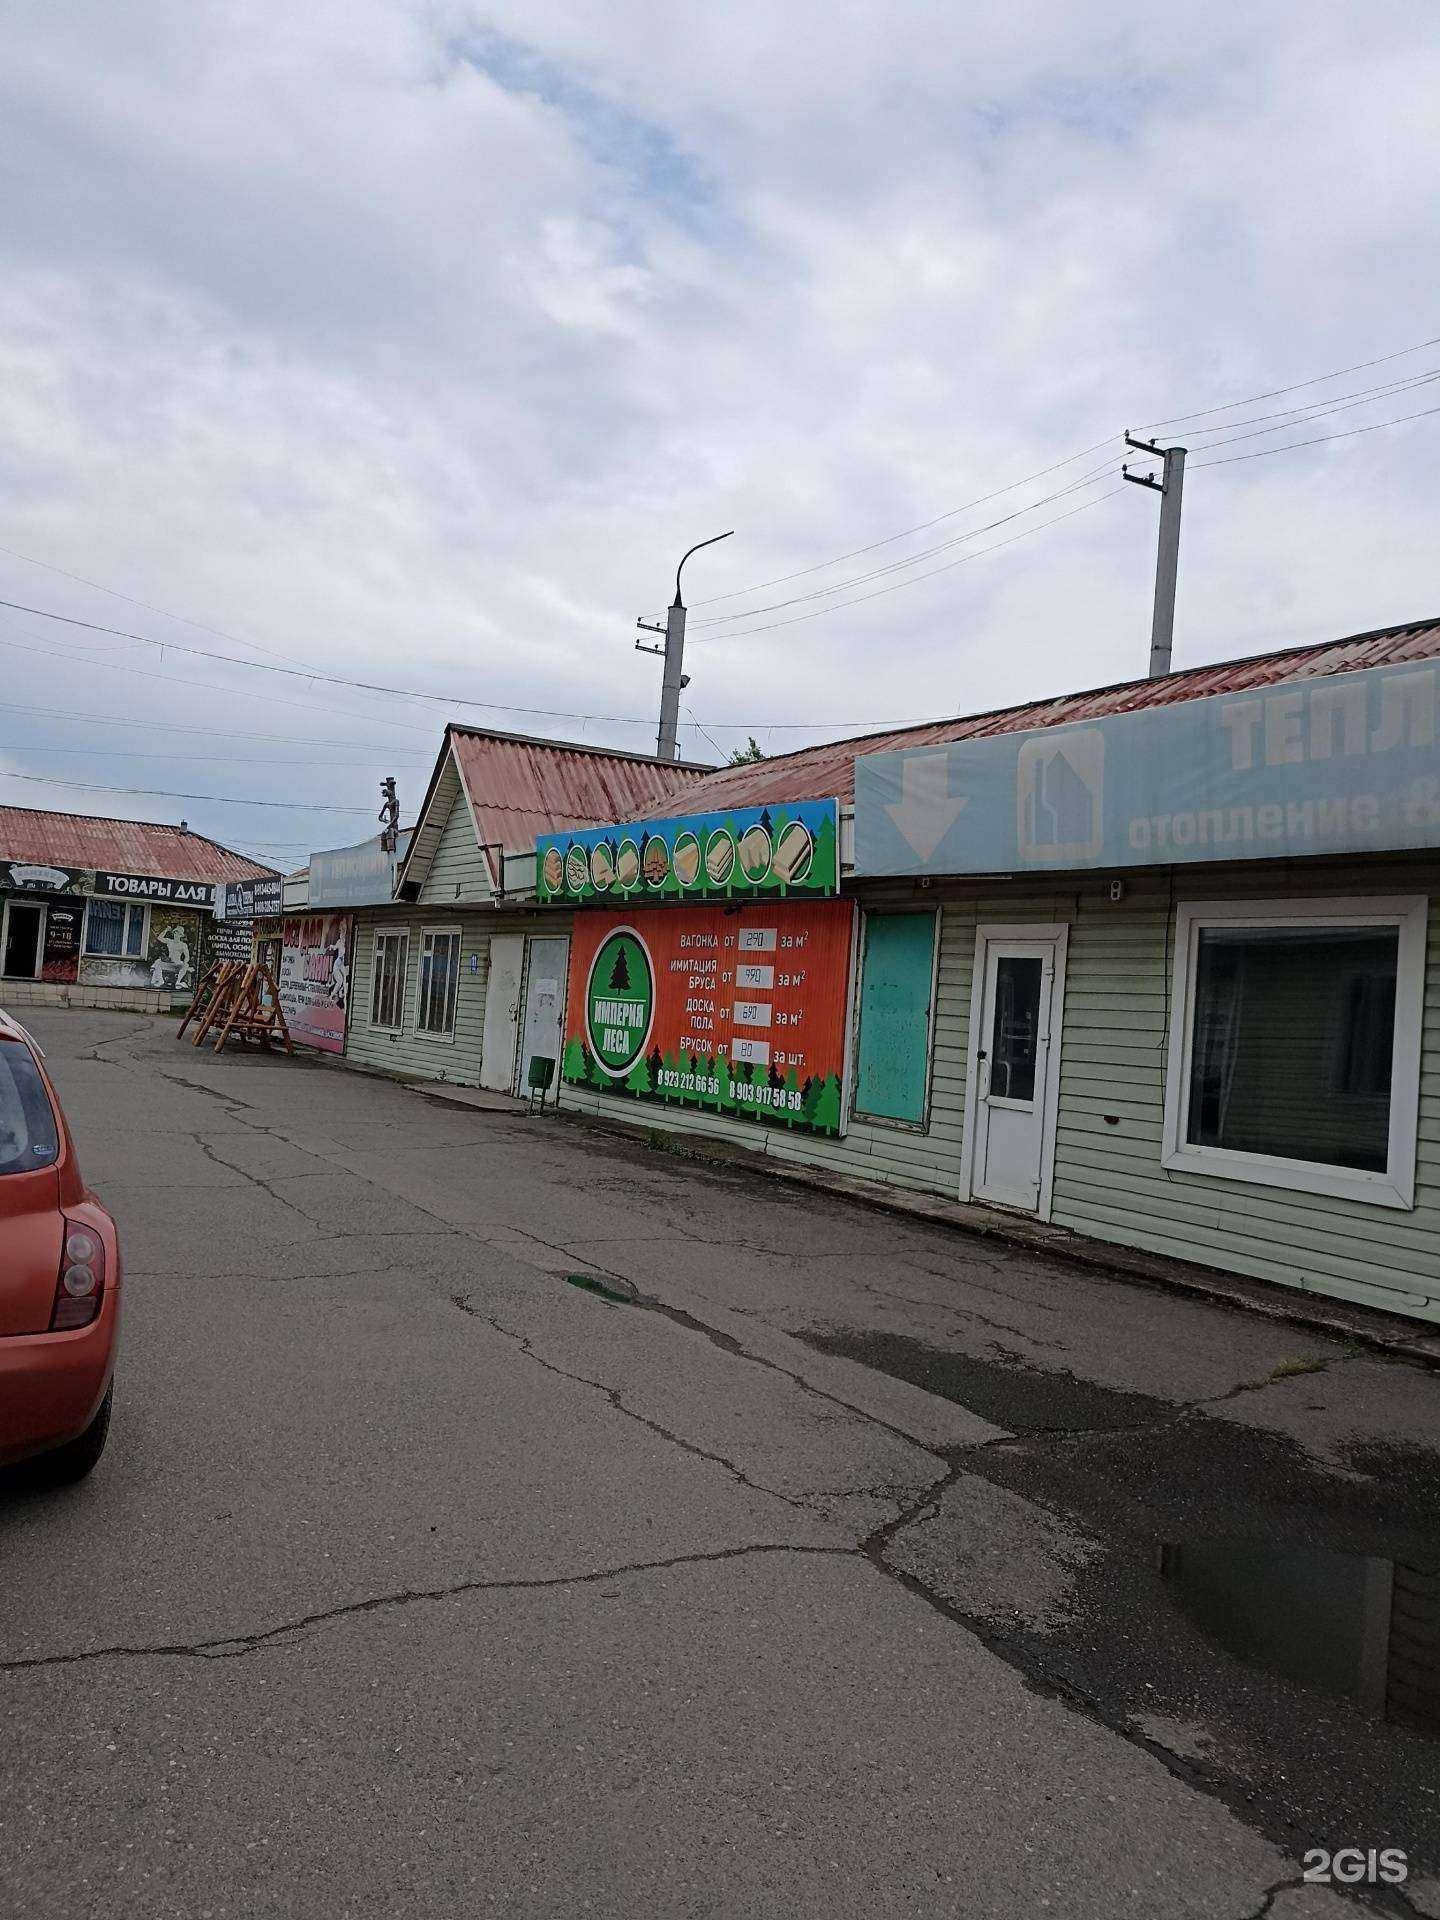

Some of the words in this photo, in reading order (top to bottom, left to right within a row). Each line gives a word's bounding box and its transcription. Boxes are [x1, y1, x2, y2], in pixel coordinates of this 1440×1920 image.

[1128, 794, 1380, 848] отопление
[106, 876, 171, 897] ТОВАРЫ
[174, 884, 206, 901] ДЛЯ
[680, 934, 718, 948] ВАГОНКА
[746, 933, 764, 947] 290
[781, 936, 793, 948] за
[670, 959, 717, 974] ИМИТАЦИЯ
[689, 976, 716, 990] БРУСА
[778, 974, 790, 986] за
[594, 1000, 644, 1028] ИМПЕРИЯ
[686, 998, 715, 1013] ДОСКА
[690, 1015, 714, 1030] ПОЛА
[775, 1012, 788, 1025] за
[602, 1028, 630, 1055] ЛЕСА
[680, 1036, 712, 1053] БРУСОК
[773, 1050, 786, 1064] за
[788, 1052, 806, 1066] шт.
[664, 1070, 679, 1088] 923
[680, 1072, 694, 1090] 212
